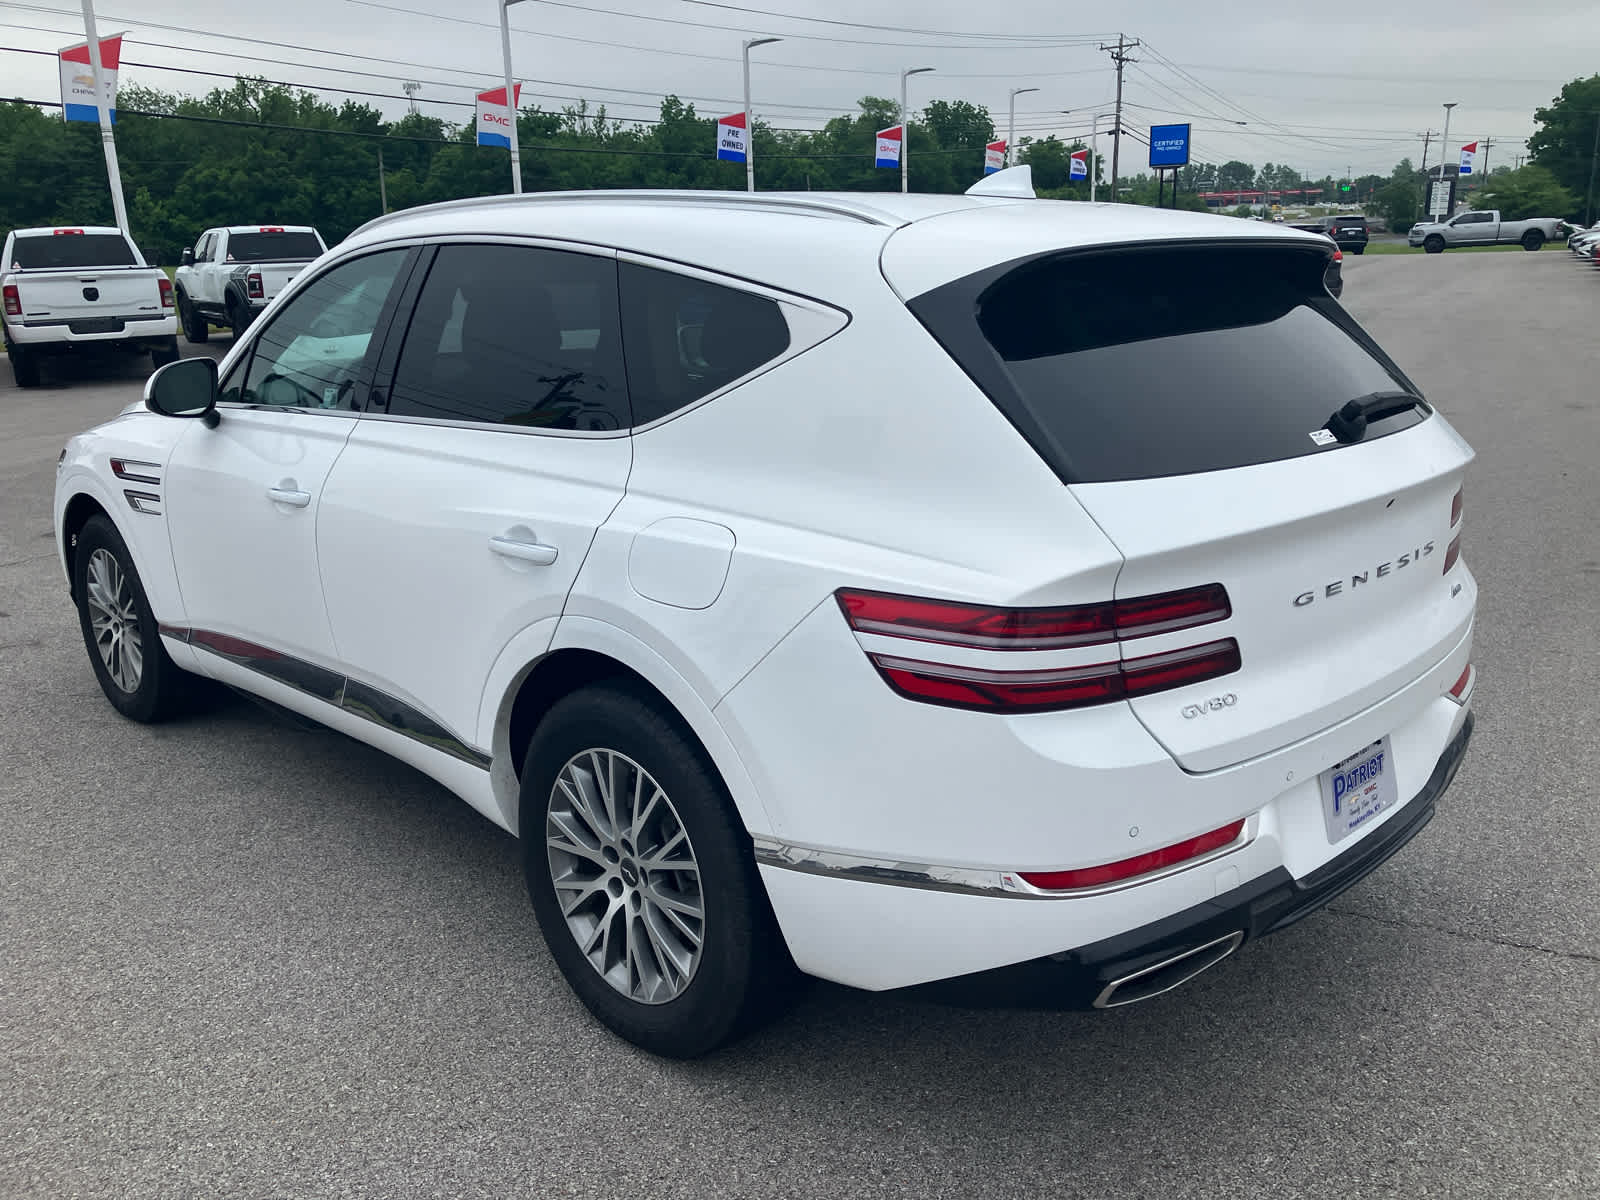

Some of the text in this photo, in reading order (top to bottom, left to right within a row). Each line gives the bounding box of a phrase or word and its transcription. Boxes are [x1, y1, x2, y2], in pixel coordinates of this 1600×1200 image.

[483, 113, 510, 126] GMC
[727, 129, 740, 138] PRE
[722, 139, 744, 150] OWNED
[1154, 139, 1184, 147] CERTIFIED
[880, 145, 897, 154] GMC
[1293, 540, 1435, 607] GENESIS
[1181, 693, 1238, 719] GV80
[1363, 782, 1377, 795] GMC
